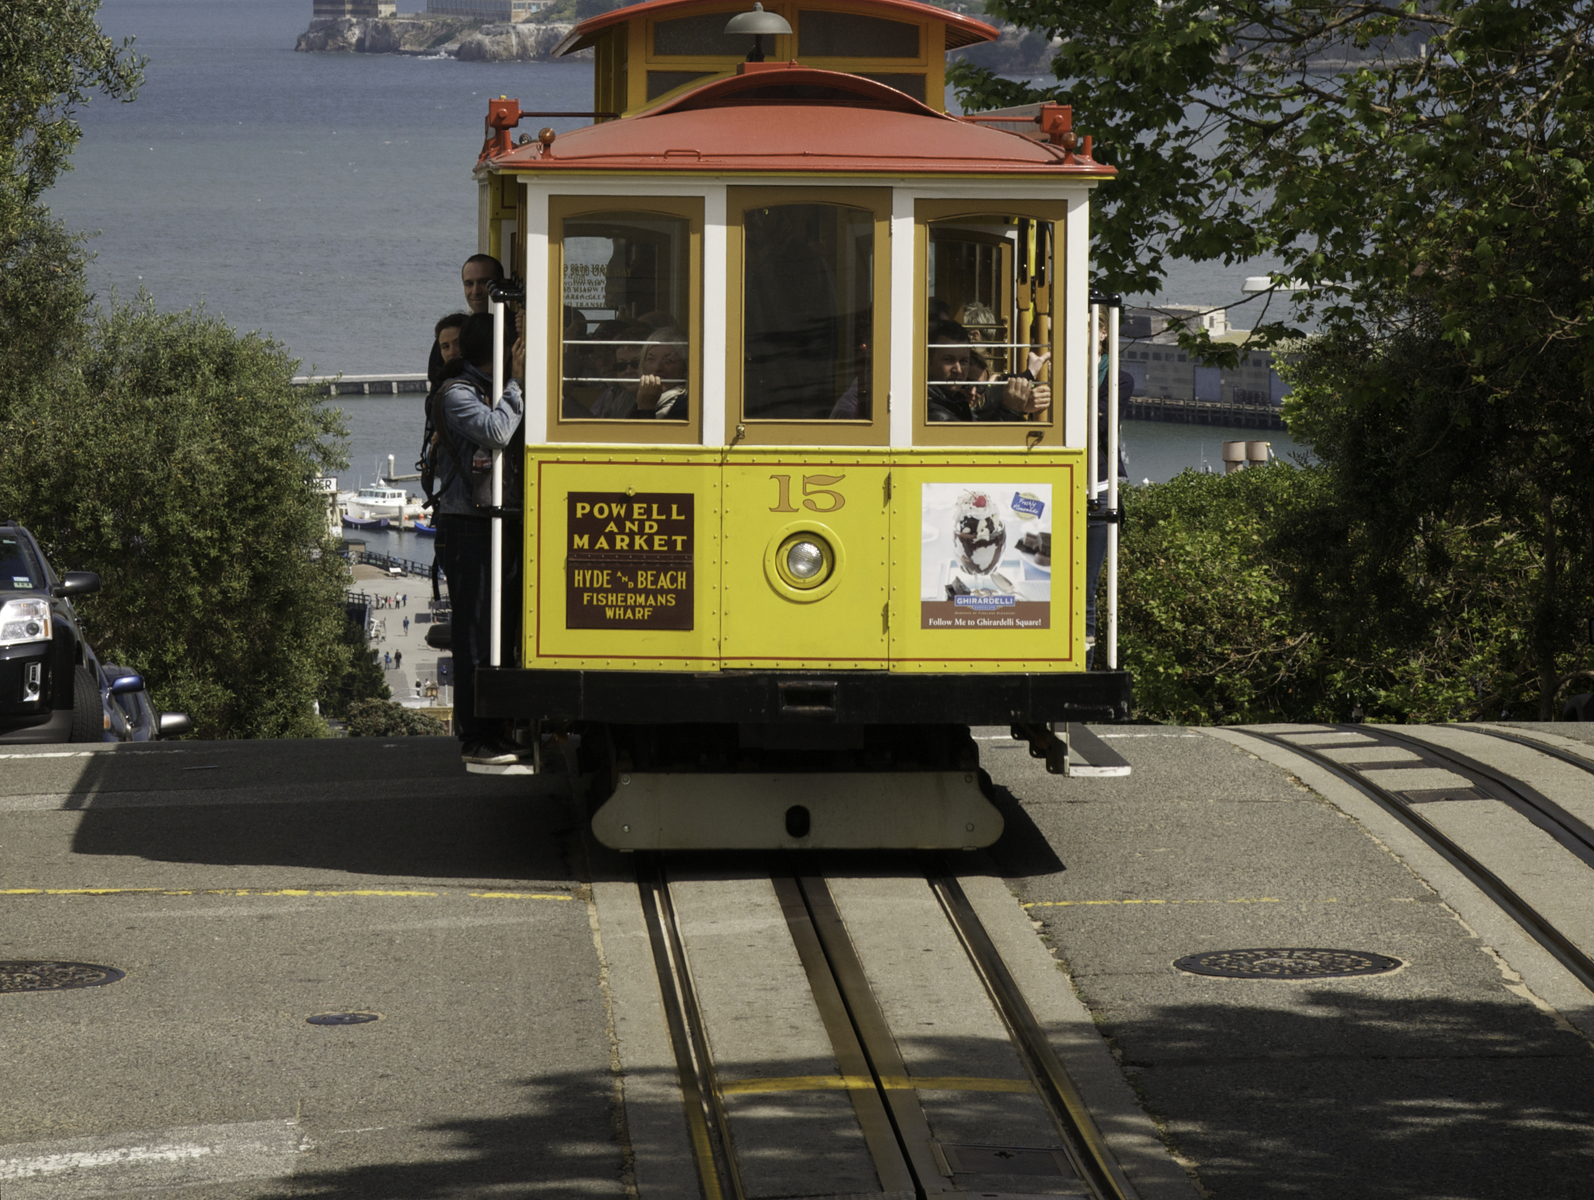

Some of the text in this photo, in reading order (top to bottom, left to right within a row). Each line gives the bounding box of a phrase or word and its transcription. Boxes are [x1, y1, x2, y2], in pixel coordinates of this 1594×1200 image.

[768, 474, 846, 512] 15
[575, 502, 685, 520] POWELL
[604, 520, 659, 533] AND
[573, 534, 688, 551] MARKET
[574, 570, 687, 589] HYDE AND BEACH
[583, 592, 676, 606] FISHERMANS
[956, 597, 1013, 605] GHIRARDELLI
[605, 607, 653, 620] WHARF
[928, 618, 953, 626] Follow
[954, 618, 966, 626] Me
[976, 618, 1014, 626] Ghirardelli
[1015, 618, 1042, 628] Square!
